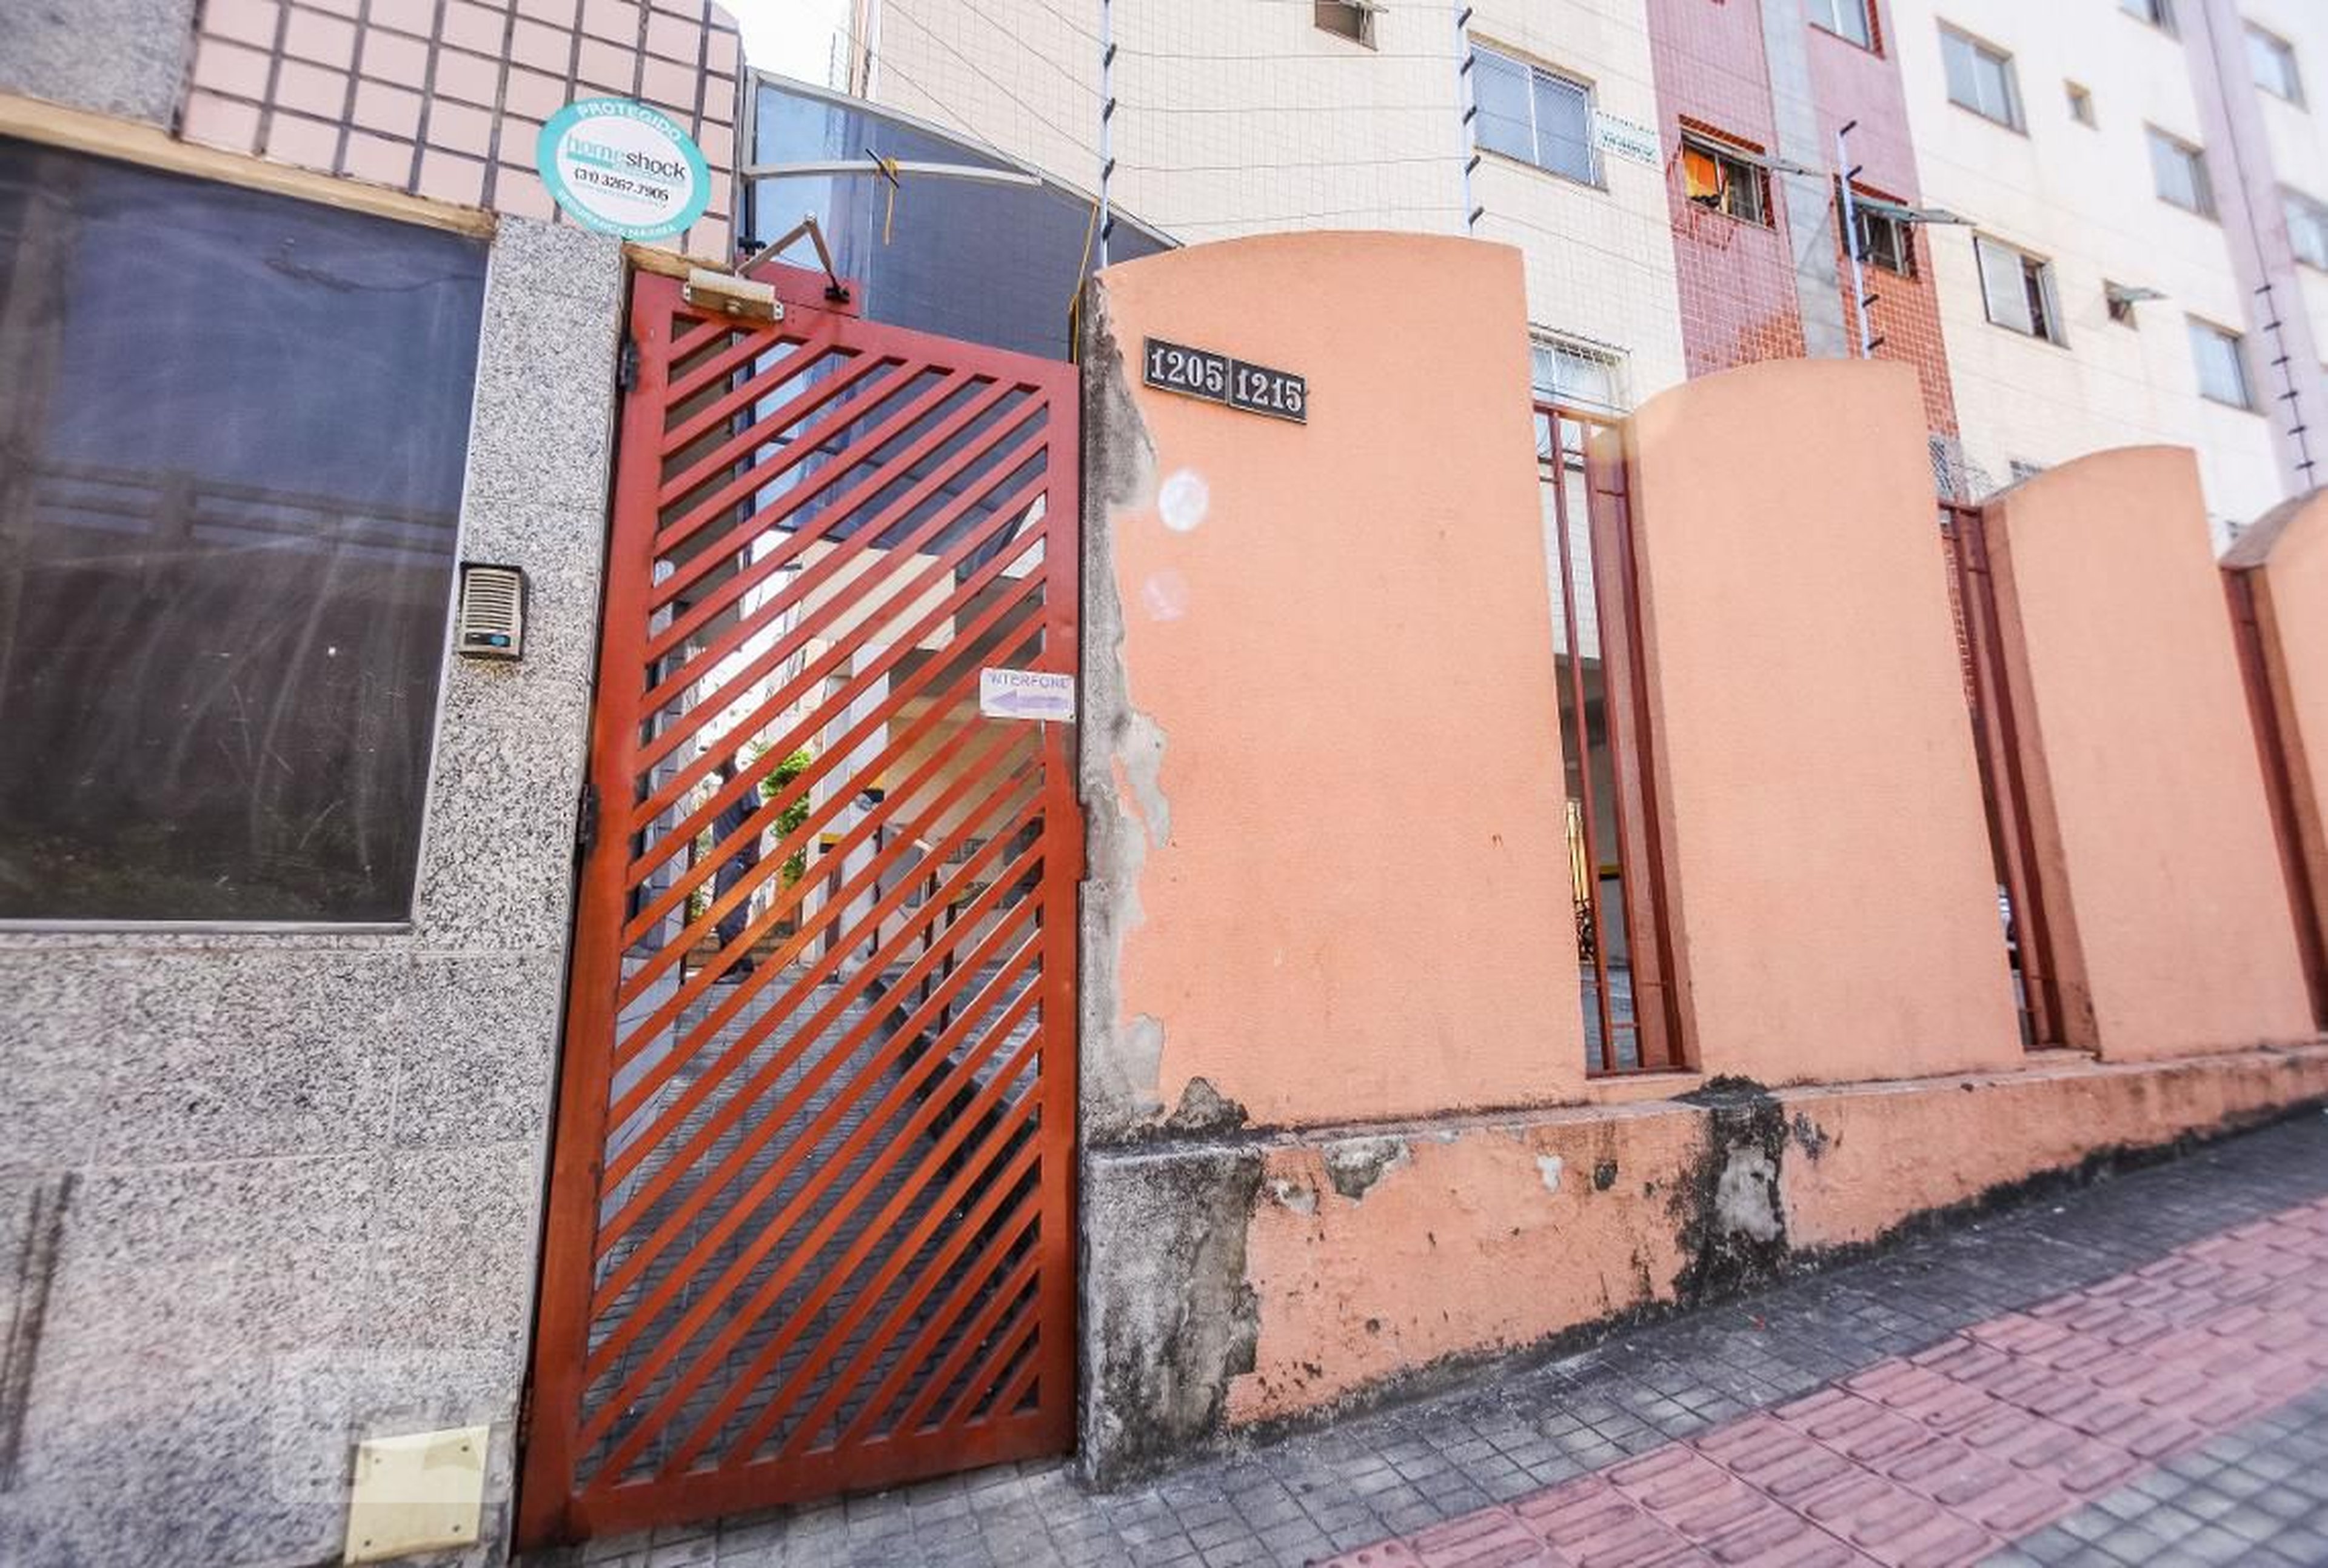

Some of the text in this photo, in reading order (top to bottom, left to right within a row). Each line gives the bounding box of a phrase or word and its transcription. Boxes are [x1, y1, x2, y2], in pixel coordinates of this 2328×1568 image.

[578, 102, 682, 141] PROTEGIDO
[566, 132, 686, 181] homeshock
[574, 167, 599, 184] (31)
[1151, 348, 1302, 412] 1205 1215
